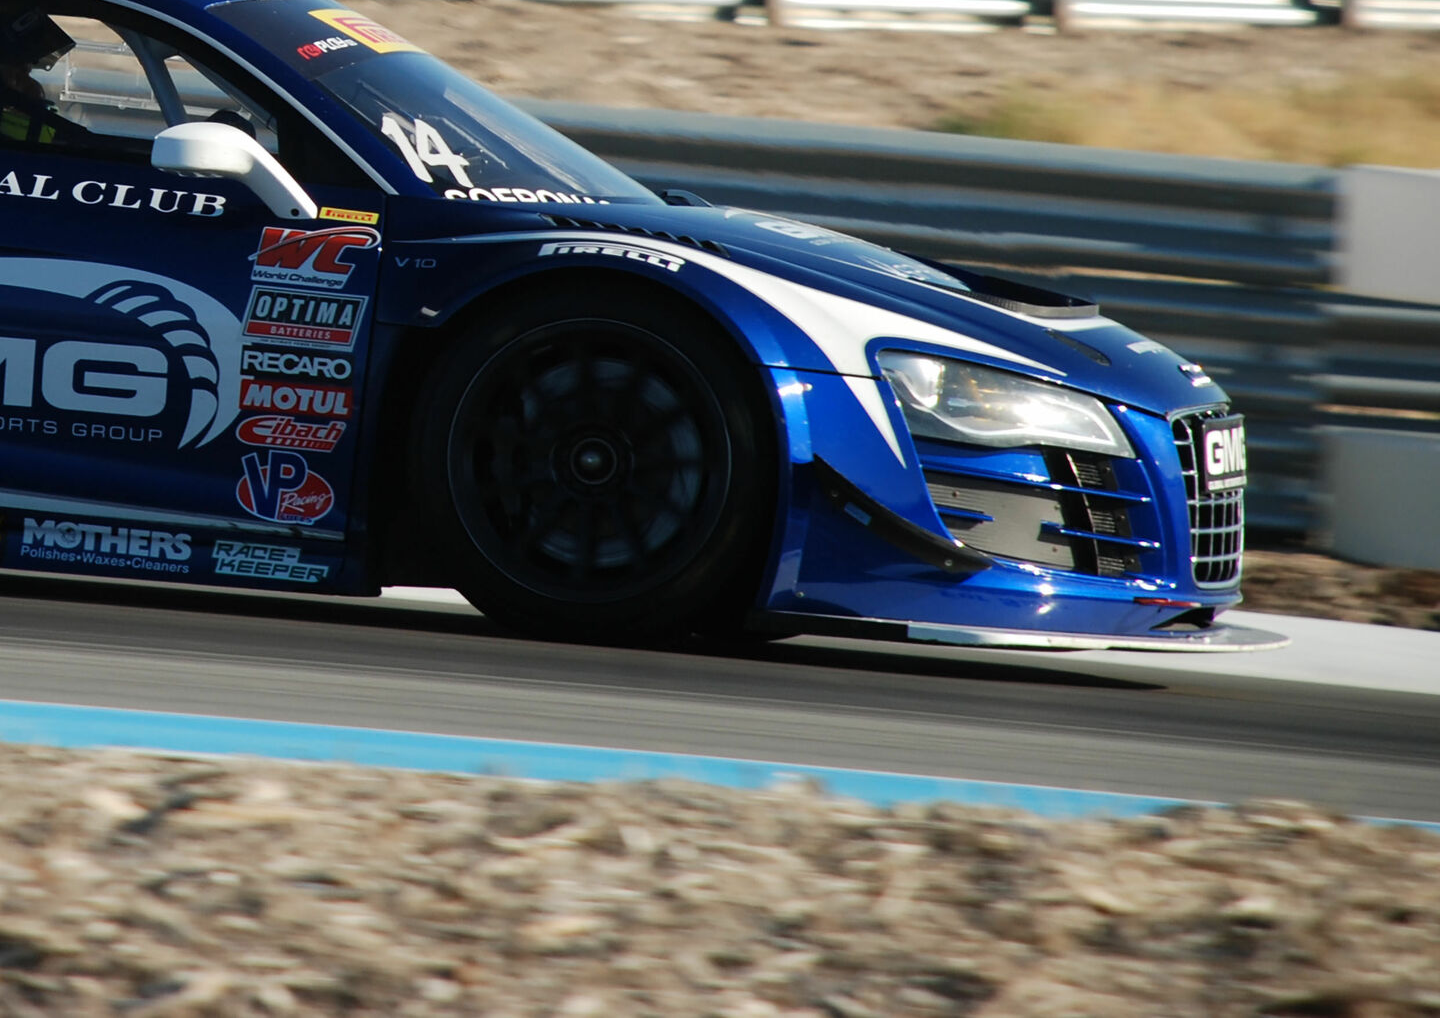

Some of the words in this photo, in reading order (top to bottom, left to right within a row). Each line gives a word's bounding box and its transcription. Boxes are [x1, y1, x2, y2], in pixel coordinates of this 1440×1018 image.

[381, 112, 475, 189] 14
[71, 180, 228, 218] CLUB
[256, 226, 373, 276] WC
[537, 241, 686, 273] PIRELLI
[252, 269, 287, 280] World
[288, 273, 344, 287] Challenge
[254, 294, 355, 327] OPTIMA
[269, 325, 332, 340] BATTERIES
[241, 349, 353, 380] RECARO
[242, 383, 348, 415] MOTUL
[71, 422, 165, 443] GROUP
[237, 415, 345, 445] Eibach
[240, 448, 309, 522] VP
[279, 490, 331, 513] Racing
[21, 516, 192, 562] MOTHERS
[215, 542, 297, 562] RACE-
[218, 557, 327, 581] KEEPER
